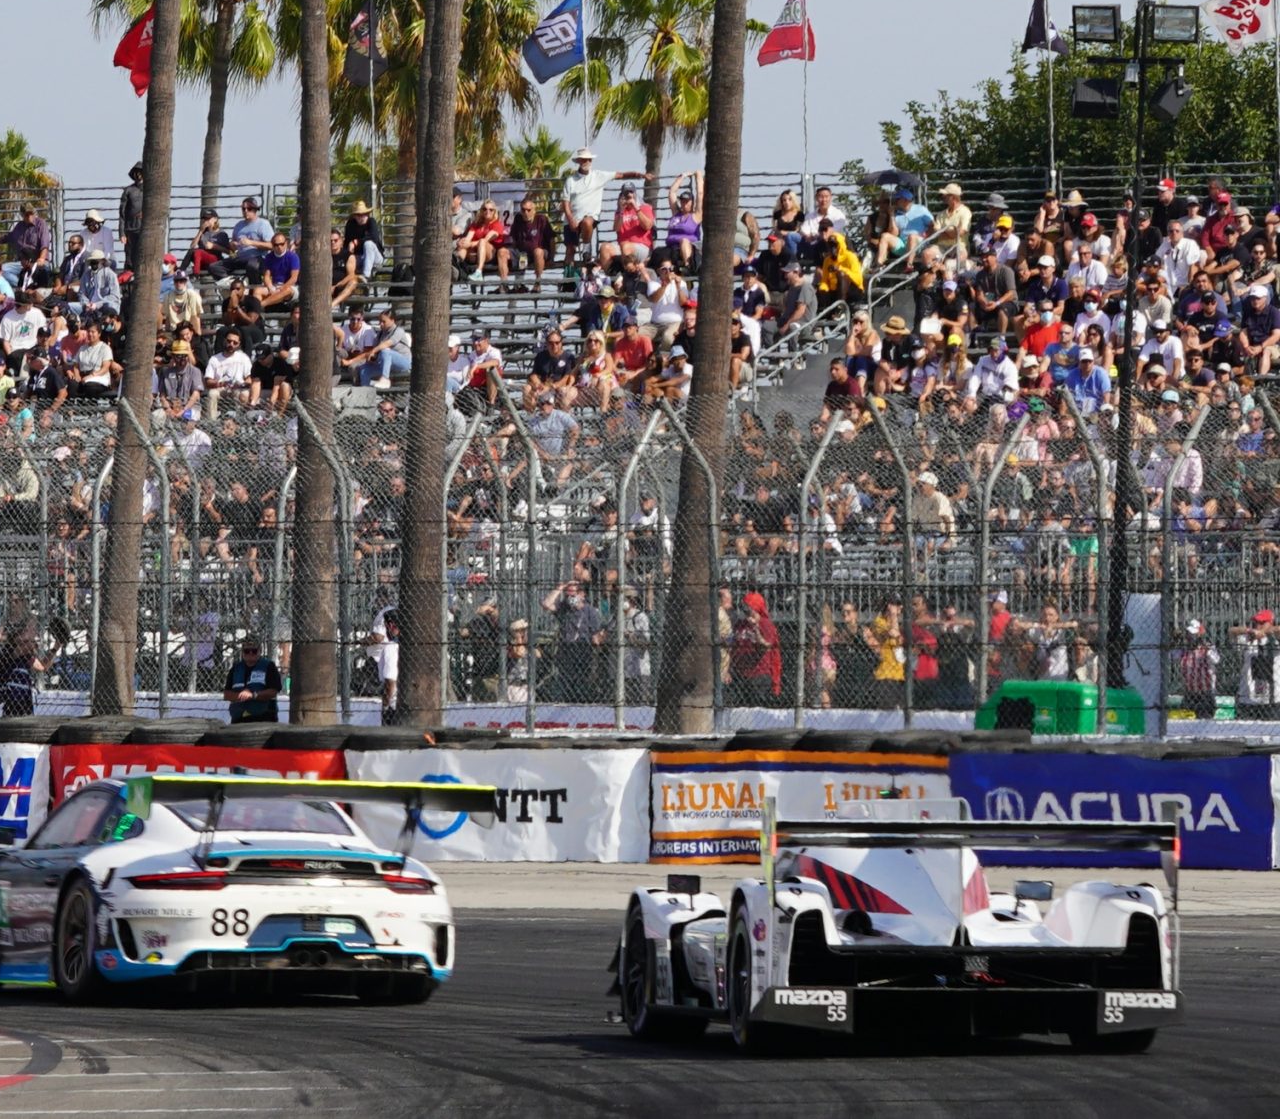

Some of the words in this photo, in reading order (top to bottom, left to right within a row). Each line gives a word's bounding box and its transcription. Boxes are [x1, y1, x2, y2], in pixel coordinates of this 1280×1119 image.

[1032, 792, 1241, 833] ACURA
[211, 908, 249, 937] 88
[774, 989, 847, 1006] mazda
[1105, 991, 1177, 1009] mazda
[826, 1006, 847, 1022] 55
[1104, 1007, 1124, 1023] 55
